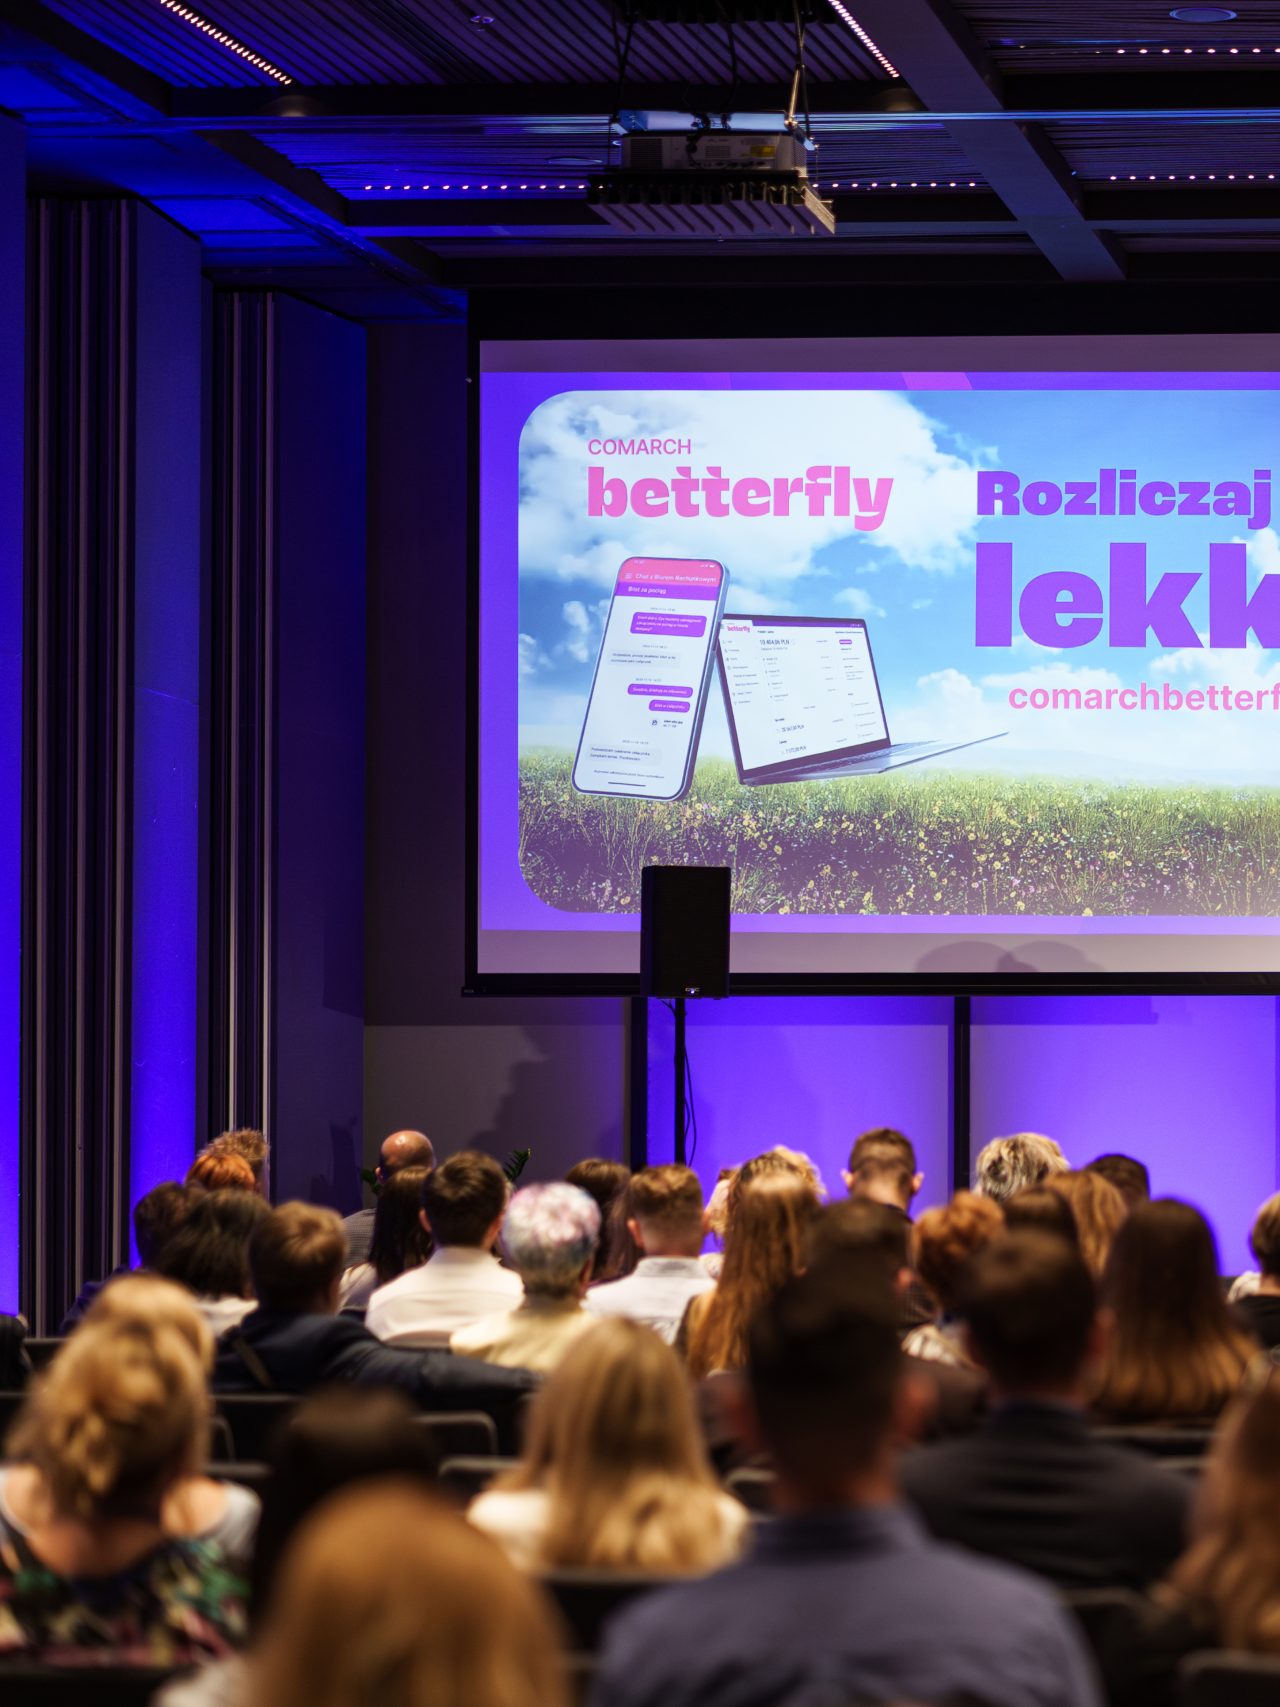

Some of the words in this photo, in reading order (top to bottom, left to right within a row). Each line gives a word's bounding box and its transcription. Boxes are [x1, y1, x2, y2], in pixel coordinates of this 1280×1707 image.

[588, 438, 691, 455] COMARCH
[587, 466, 894, 531] betterfly
[976, 468, 1272, 531] Rozliczaj
